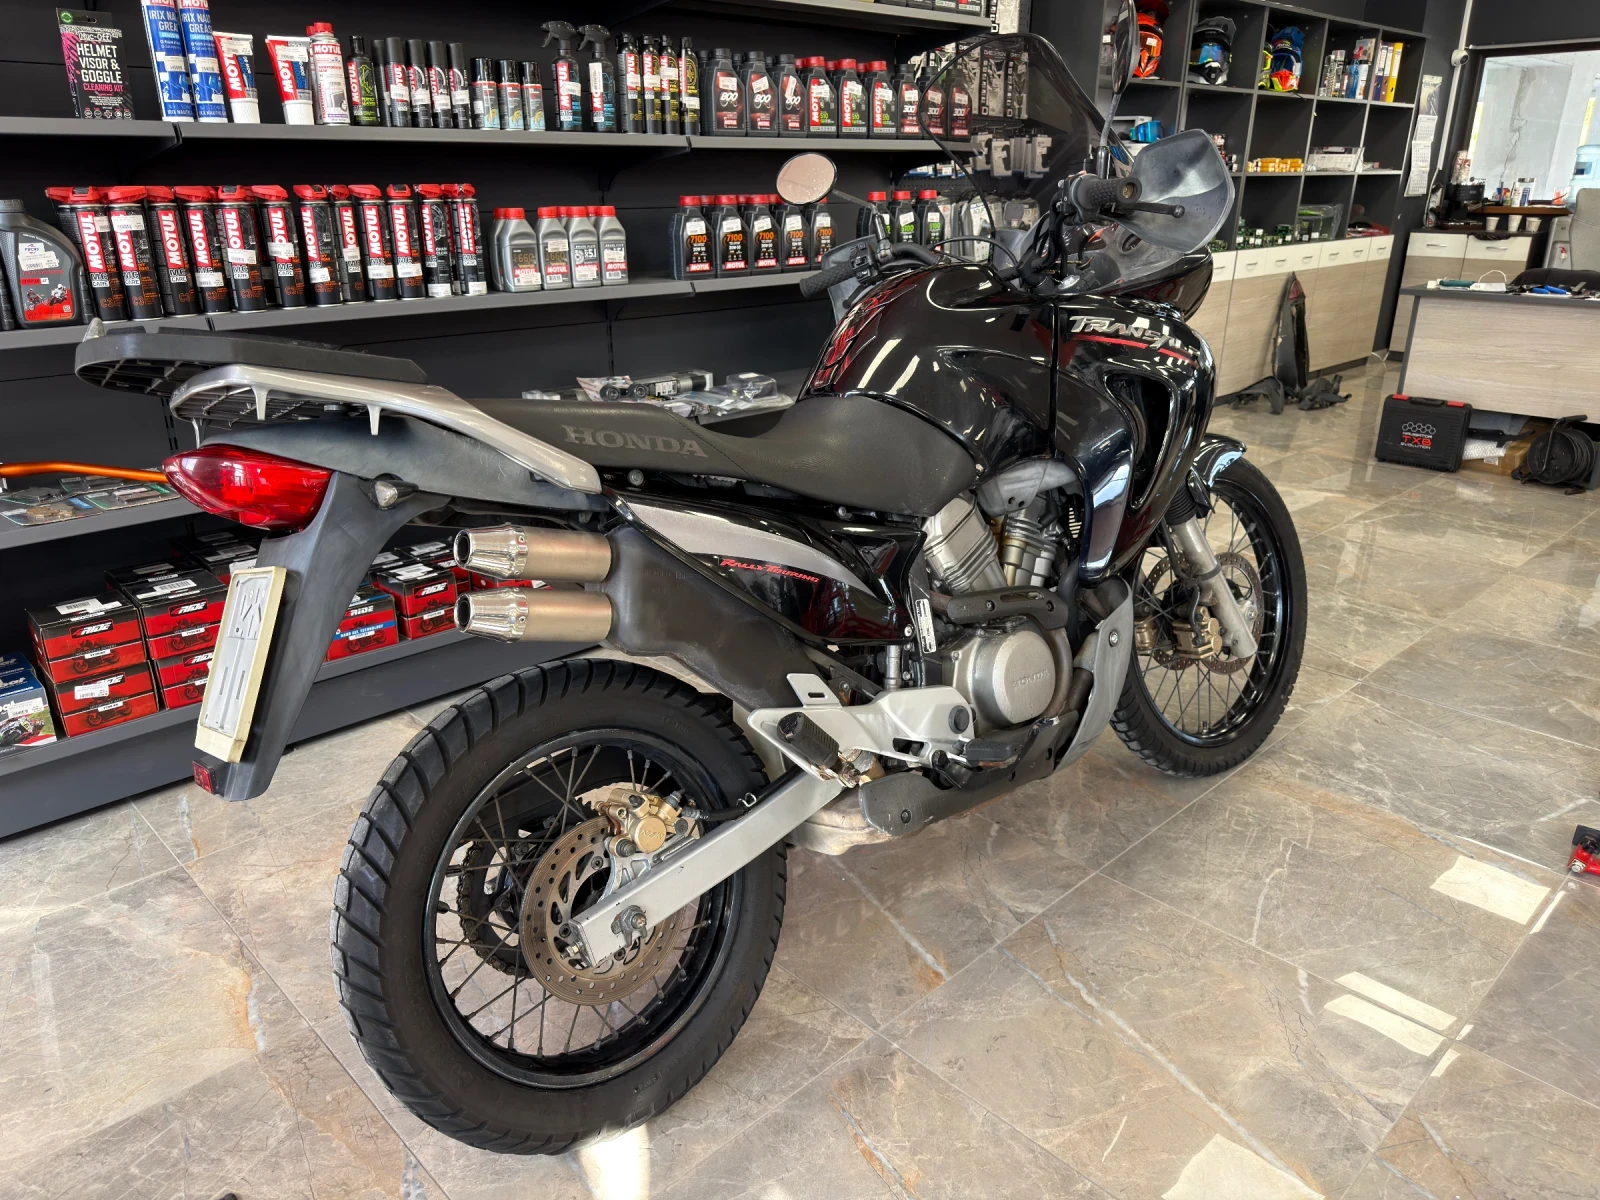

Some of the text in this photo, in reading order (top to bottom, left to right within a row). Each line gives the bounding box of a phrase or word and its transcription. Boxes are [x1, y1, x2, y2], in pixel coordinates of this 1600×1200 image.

[76, 43, 117, 58] HELMET
[314, 45, 342, 55] MOTUL
[78, 56, 120, 70] VISOR &
[81, 69, 123, 84] GOGGLE
[348, 62, 360, 103] MOTUL
[83, 83, 123, 92] CLEANING KIT
[719, 91, 739, 101] 800
[754, 93, 772, 103] 800
[225, 211, 241, 249] OTUL
[302, 209, 318, 259] MOTUL
[365, 207, 382, 255] MOTUL
[393, 207, 409, 254] MOTUL
[422, 207, 434, 253] MOTUL
[726, 233, 743, 242] 7100
[758, 232, 775, 241] 7100
[789, 230, 804, 239] 7100
[818, 228, 832, 237] 7100
[81, 214, 104, 270] MOTUL
[161, 213, 182, 266] MOTUL
[190, 212, 209, 265] MOTUL
[690, 235, 707, 243] 7100
[560, 423, 709, 458] HONDA
[719, 558, 820, 583] RALLY TOURING
